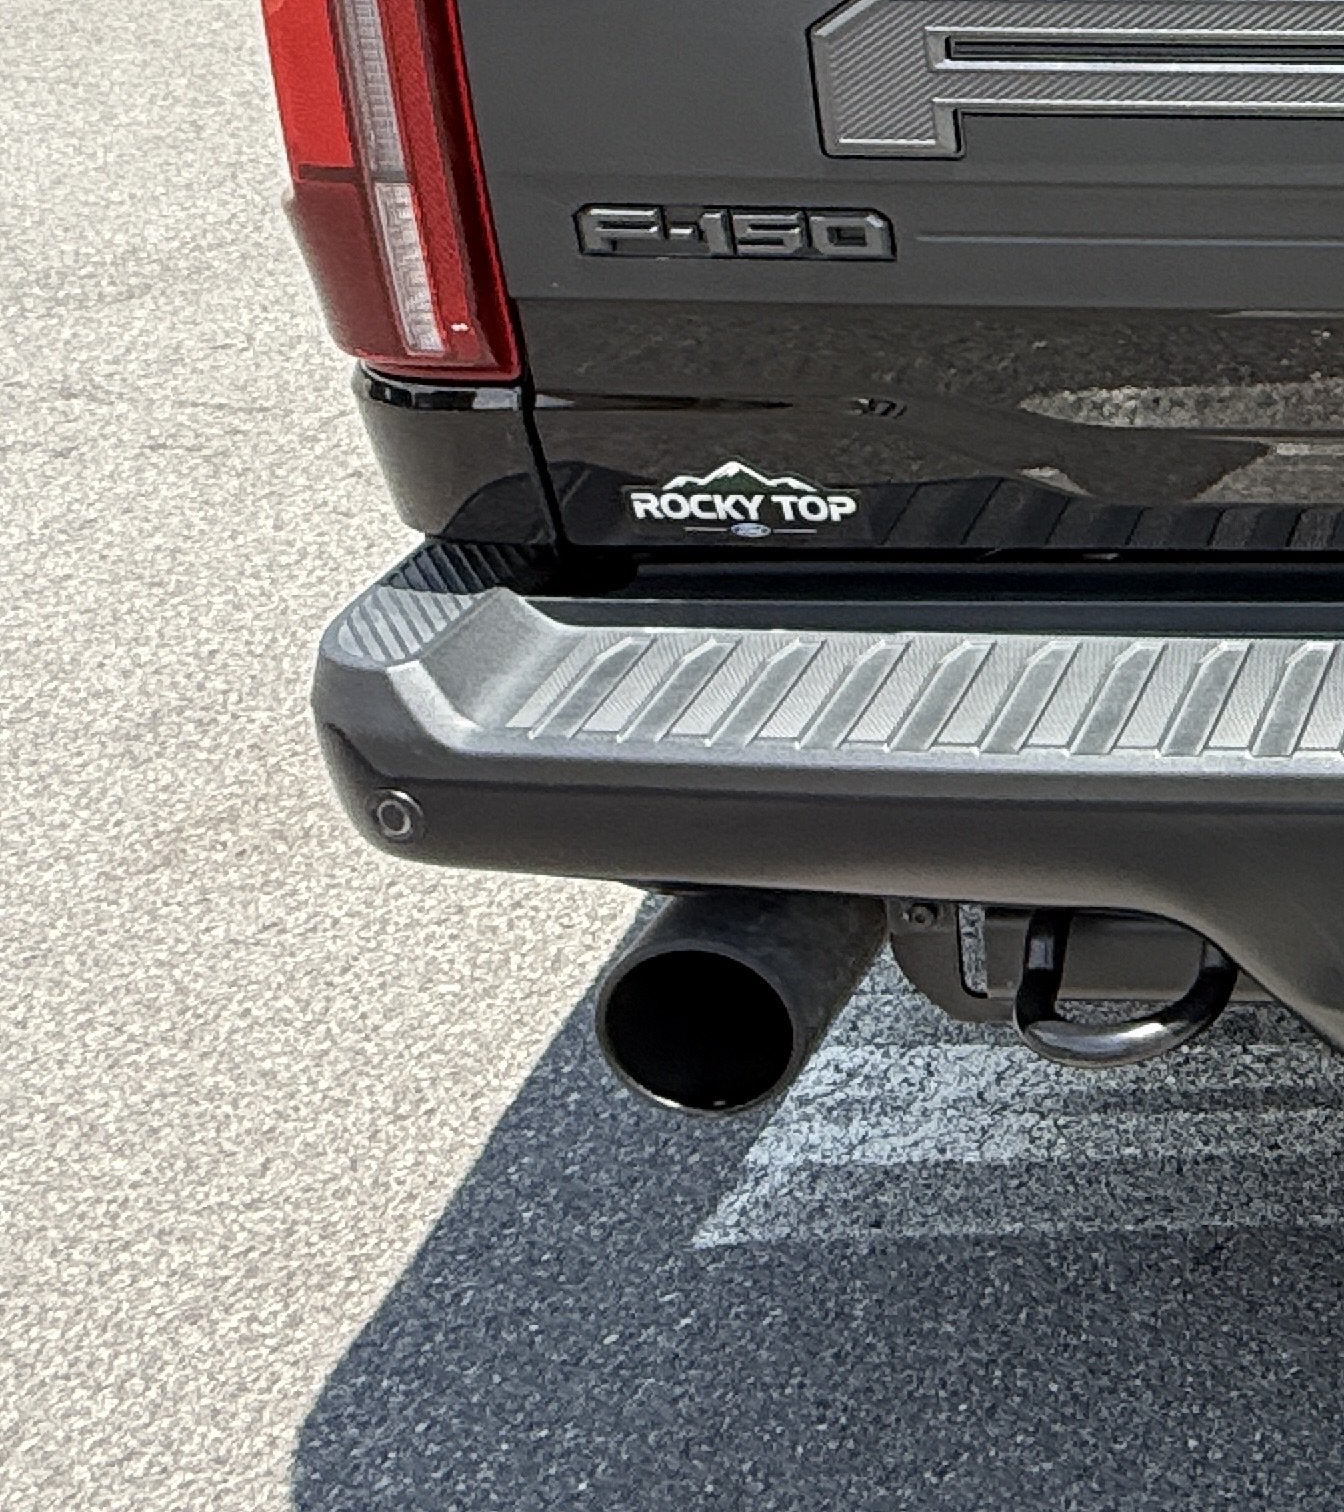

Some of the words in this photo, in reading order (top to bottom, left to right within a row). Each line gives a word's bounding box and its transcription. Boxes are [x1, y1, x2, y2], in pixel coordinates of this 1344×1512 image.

[573, 202, 898, 261] F-150
[630, 492, 765, 521] ROCKY
[770, 494, 858, 522] TOP
